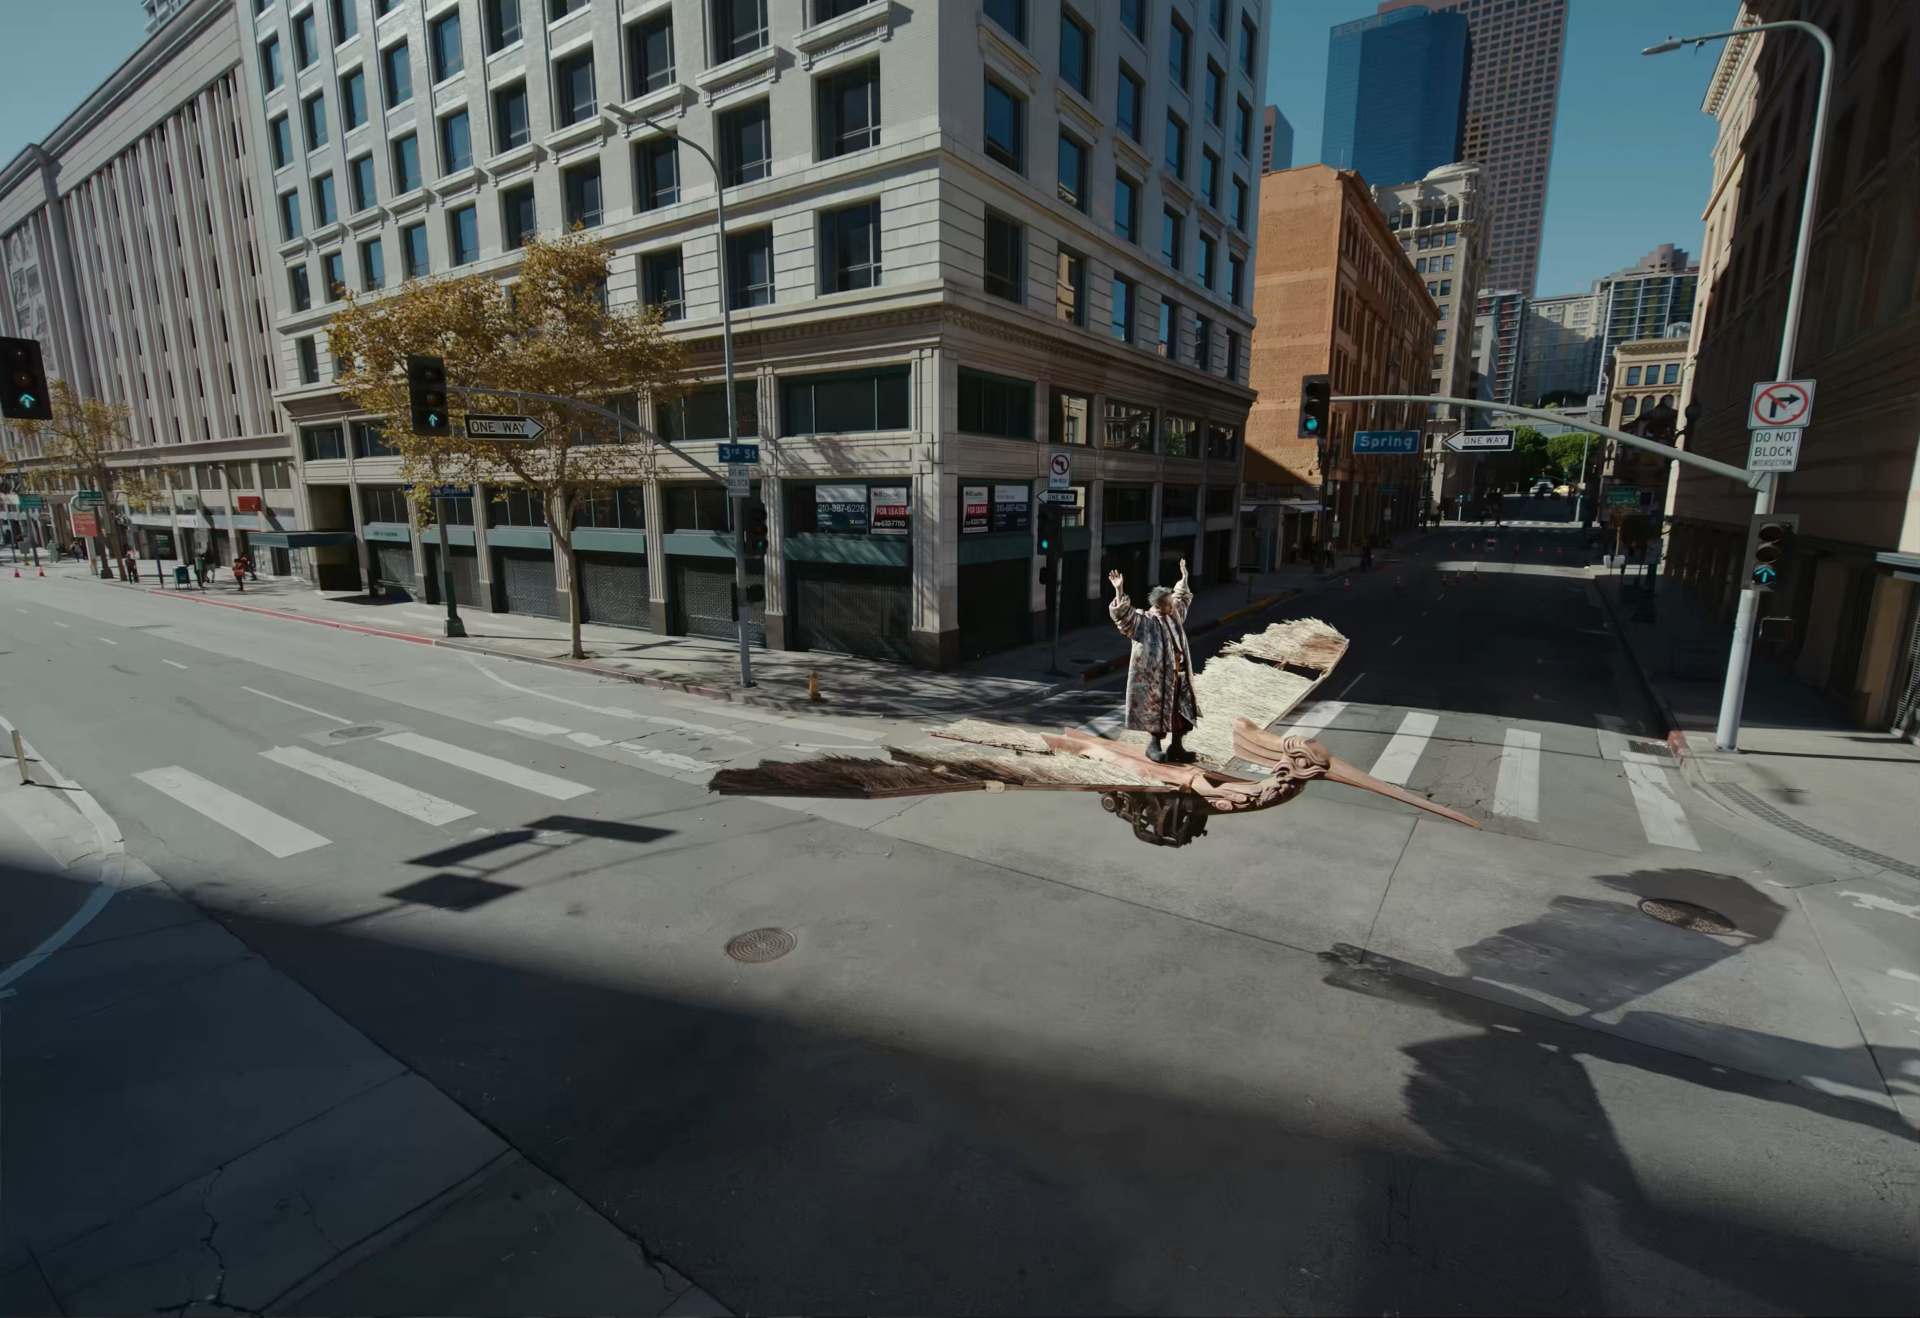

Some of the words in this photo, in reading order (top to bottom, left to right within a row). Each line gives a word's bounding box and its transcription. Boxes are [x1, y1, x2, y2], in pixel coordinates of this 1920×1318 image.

[471, 421, 495, 433] ONE
[502, 422, 526, 433] WAY
[1464, 436, 1483, 445] ONE
[1486, 436, 1506, 444] WAY
[1755, 432, 1771, 443] DO
[1775, 431, 1798, 442] NOT
[1360, 435, 1413, 450] Spring
[722, 447, 740, 460] 3rd
[744, 448, 756, 459] St
[1754, 446, 1794, 457] BLOCK
[1751, 459, 1793, 467] INTERSECTION
[730, 468, 737, 477] DO
[876, 507, 887, 515] FOR
[888, 507, 905, 515] LEASE
[967, 506, 975, 514] FOR
[975, 506, 987, 514] LEASE
